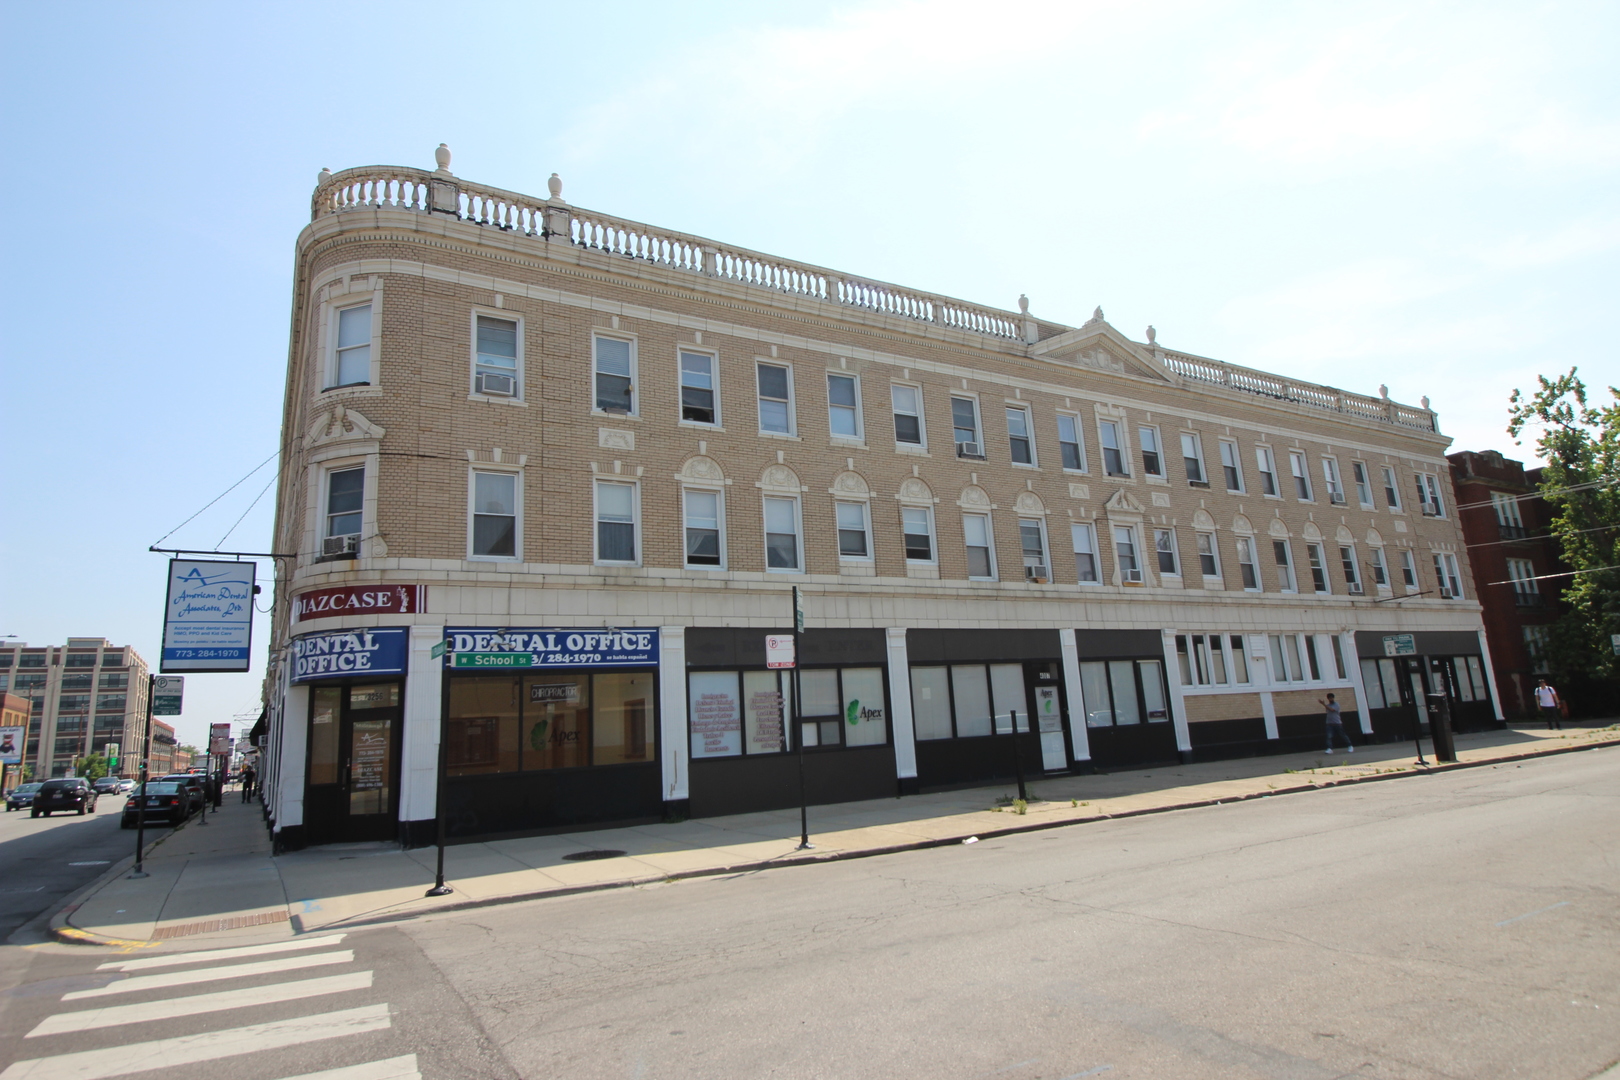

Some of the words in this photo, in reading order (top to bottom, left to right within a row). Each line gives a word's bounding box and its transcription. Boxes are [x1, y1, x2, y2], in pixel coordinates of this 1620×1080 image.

[174, 589, 216, 604] American
[217, 587, 248, 600] Dental
[295, 591, 392, 616] DIAZCASE
[178, 603, 221, 617] Associates,
[222, 602, 243, 617] Ltd.
[297, 633, 379, 657] DENTAL
[453, 634, 561, 651] DENTAL
[566, 633, 652, 651] OFFICE
[198, 649, 239, 657] 284-1970
[475, 655, 514, 665] School
[547, 653, 602, 663] 284-1970
[297, 652, 372, 675] OFFICE
[531, 686, 577, 699] CHIROPRACTOR
[1040, 688, 1053, 699] Apex
[860, 705, 882, 722] Apex
[548, 727, 581, 746] Apex
